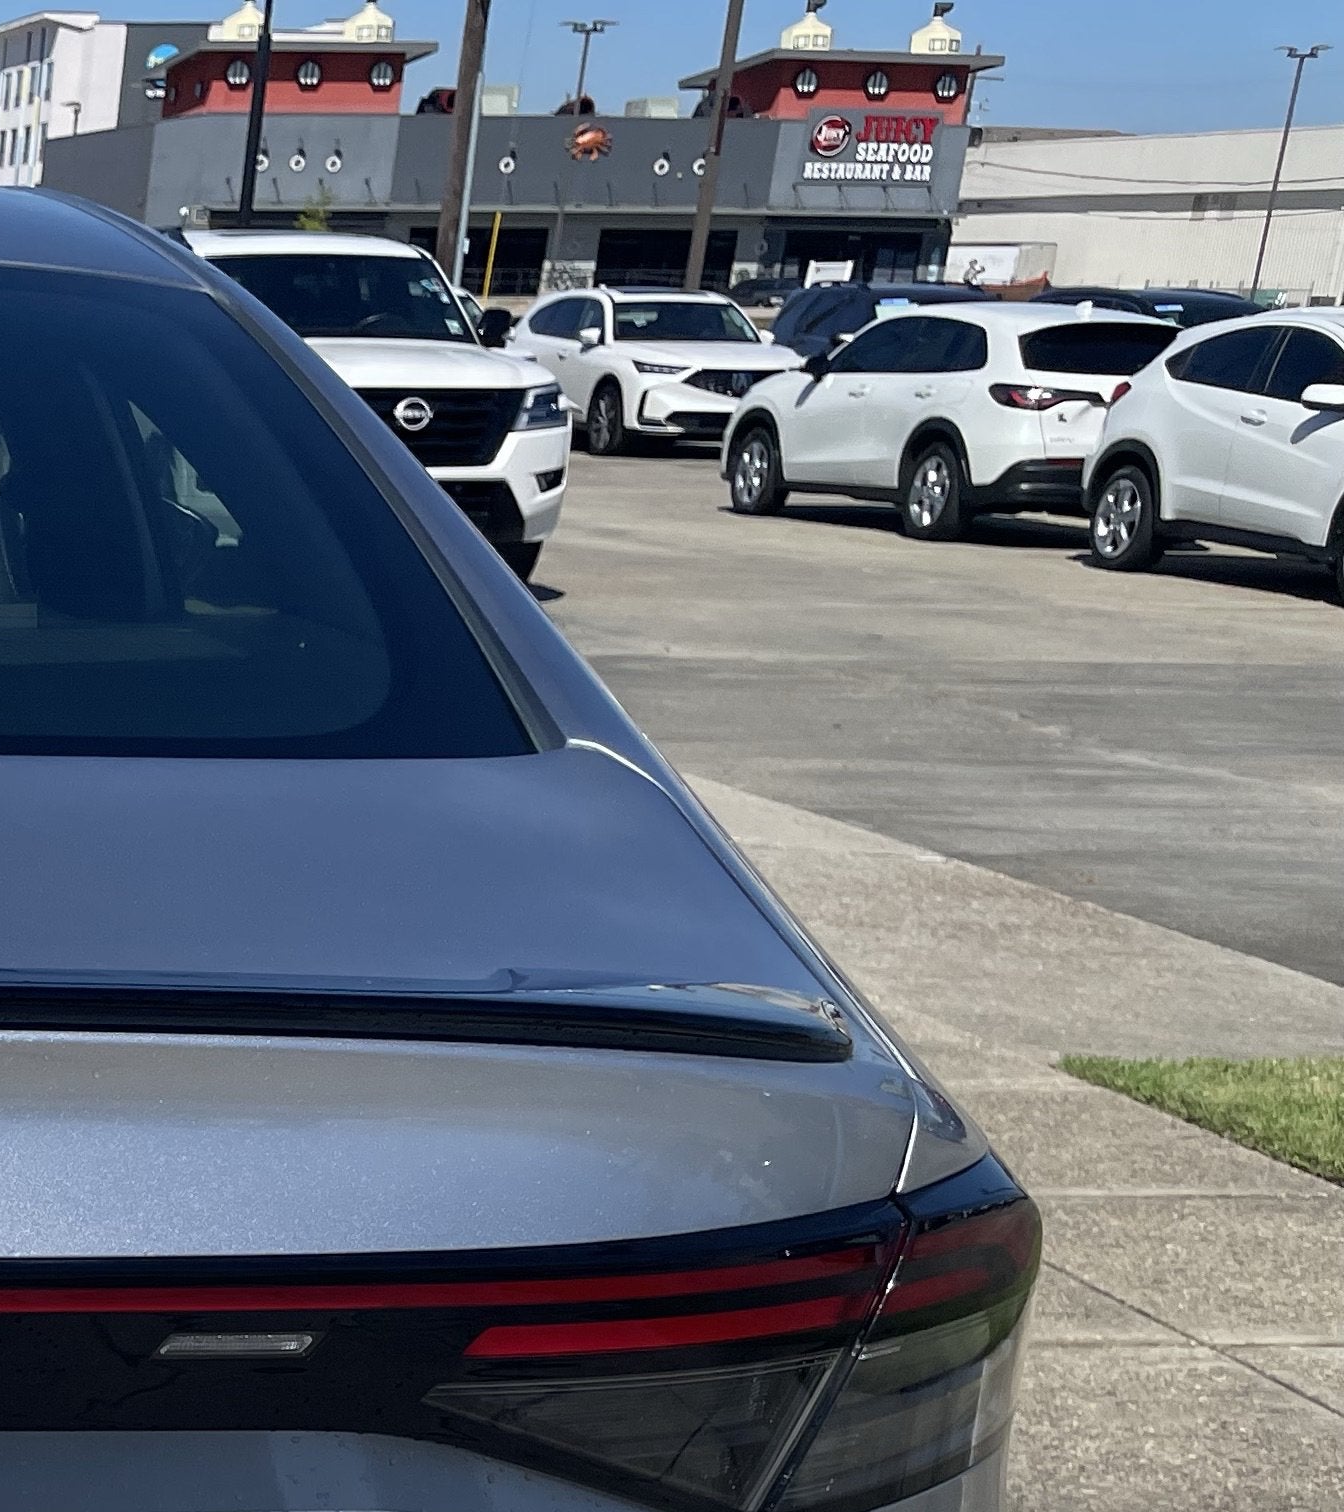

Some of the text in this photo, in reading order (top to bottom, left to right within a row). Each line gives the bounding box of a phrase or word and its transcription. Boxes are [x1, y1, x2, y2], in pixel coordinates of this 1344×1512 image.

[855, 115, 939, 144] JUICY
[855, 142, 933, 163] SEAFOOD
[803, 162, 931, 181] RESTAURANT & BAR
